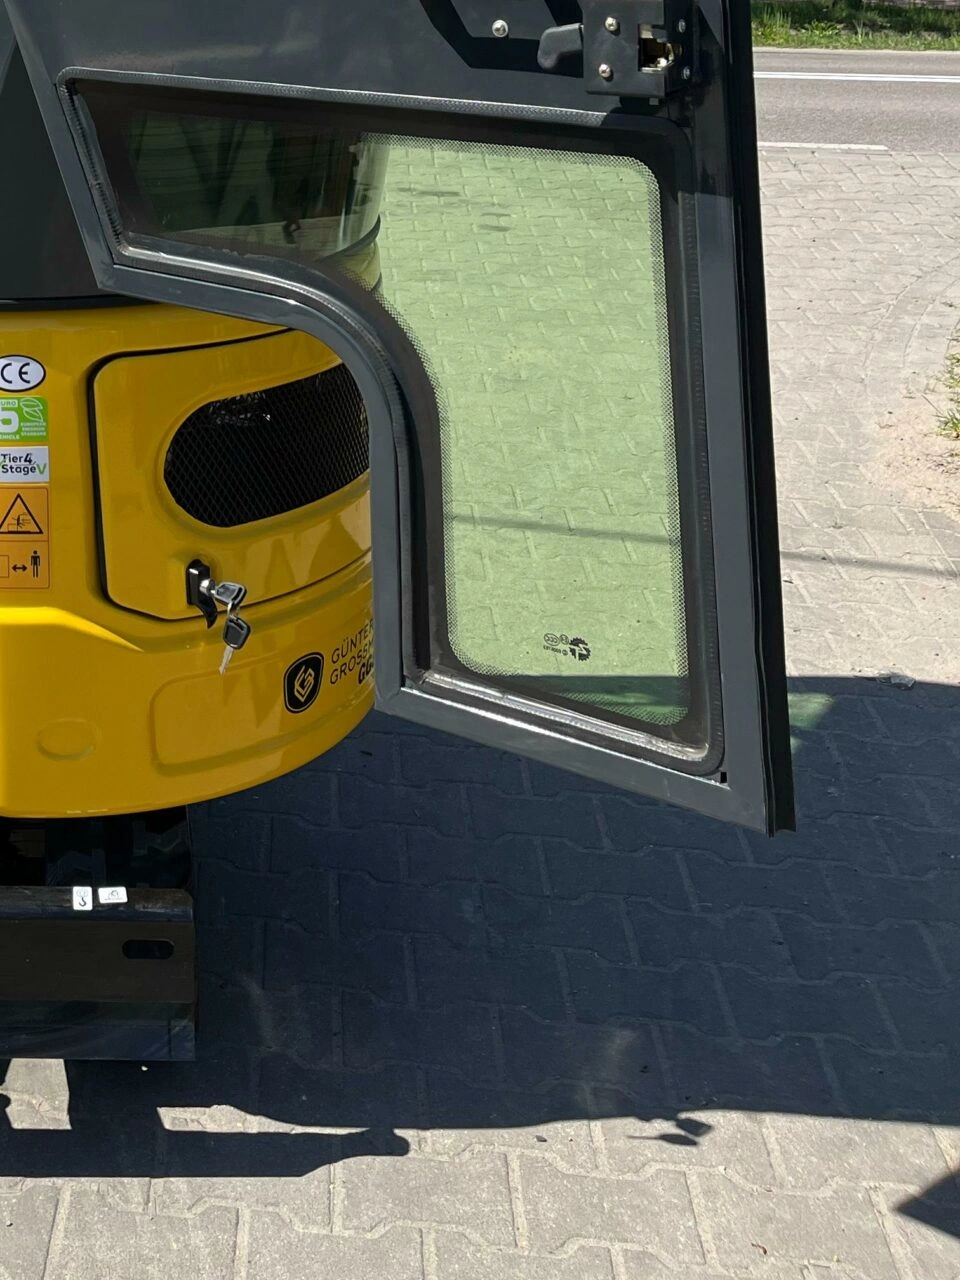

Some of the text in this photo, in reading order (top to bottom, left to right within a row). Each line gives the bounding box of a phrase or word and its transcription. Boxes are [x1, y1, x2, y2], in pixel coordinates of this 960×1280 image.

[0, 362, 31, 384] CE
[0, 452, 33, 465] Tier 4
[1, 464, 36, 476] Stage
